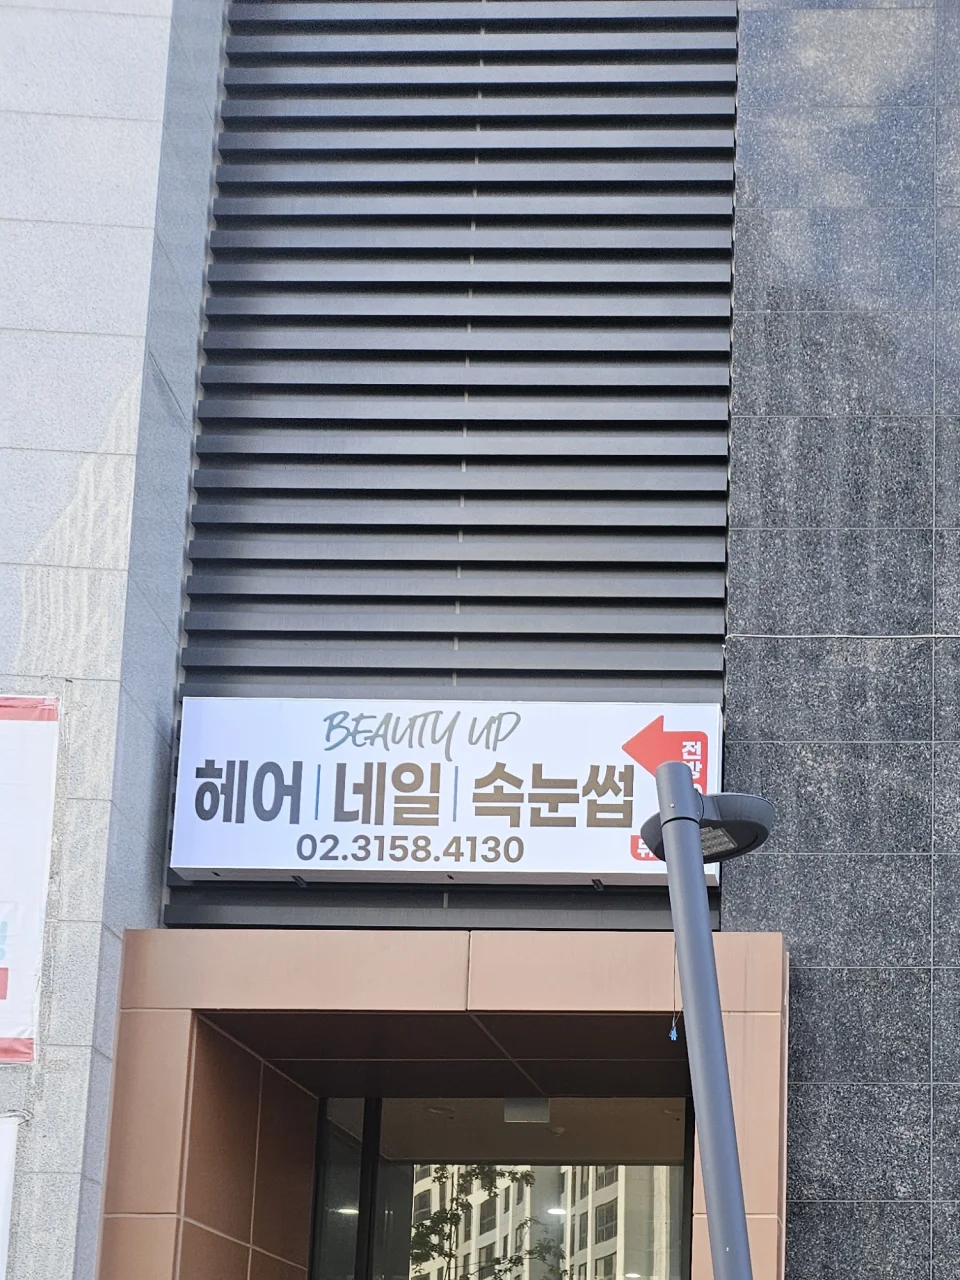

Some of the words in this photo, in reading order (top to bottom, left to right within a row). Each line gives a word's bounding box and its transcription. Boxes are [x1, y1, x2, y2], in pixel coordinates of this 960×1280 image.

[323, 710, 461, 762] BEAUTY
[468, 711, 521, 752] UP
[195, 759, 303, 824] 헤어
[334, 762, 441, 826] 네일
[472, 762, 635, 828] 속눈썹
[296, 834, 525, 863] 02.3158.4130
